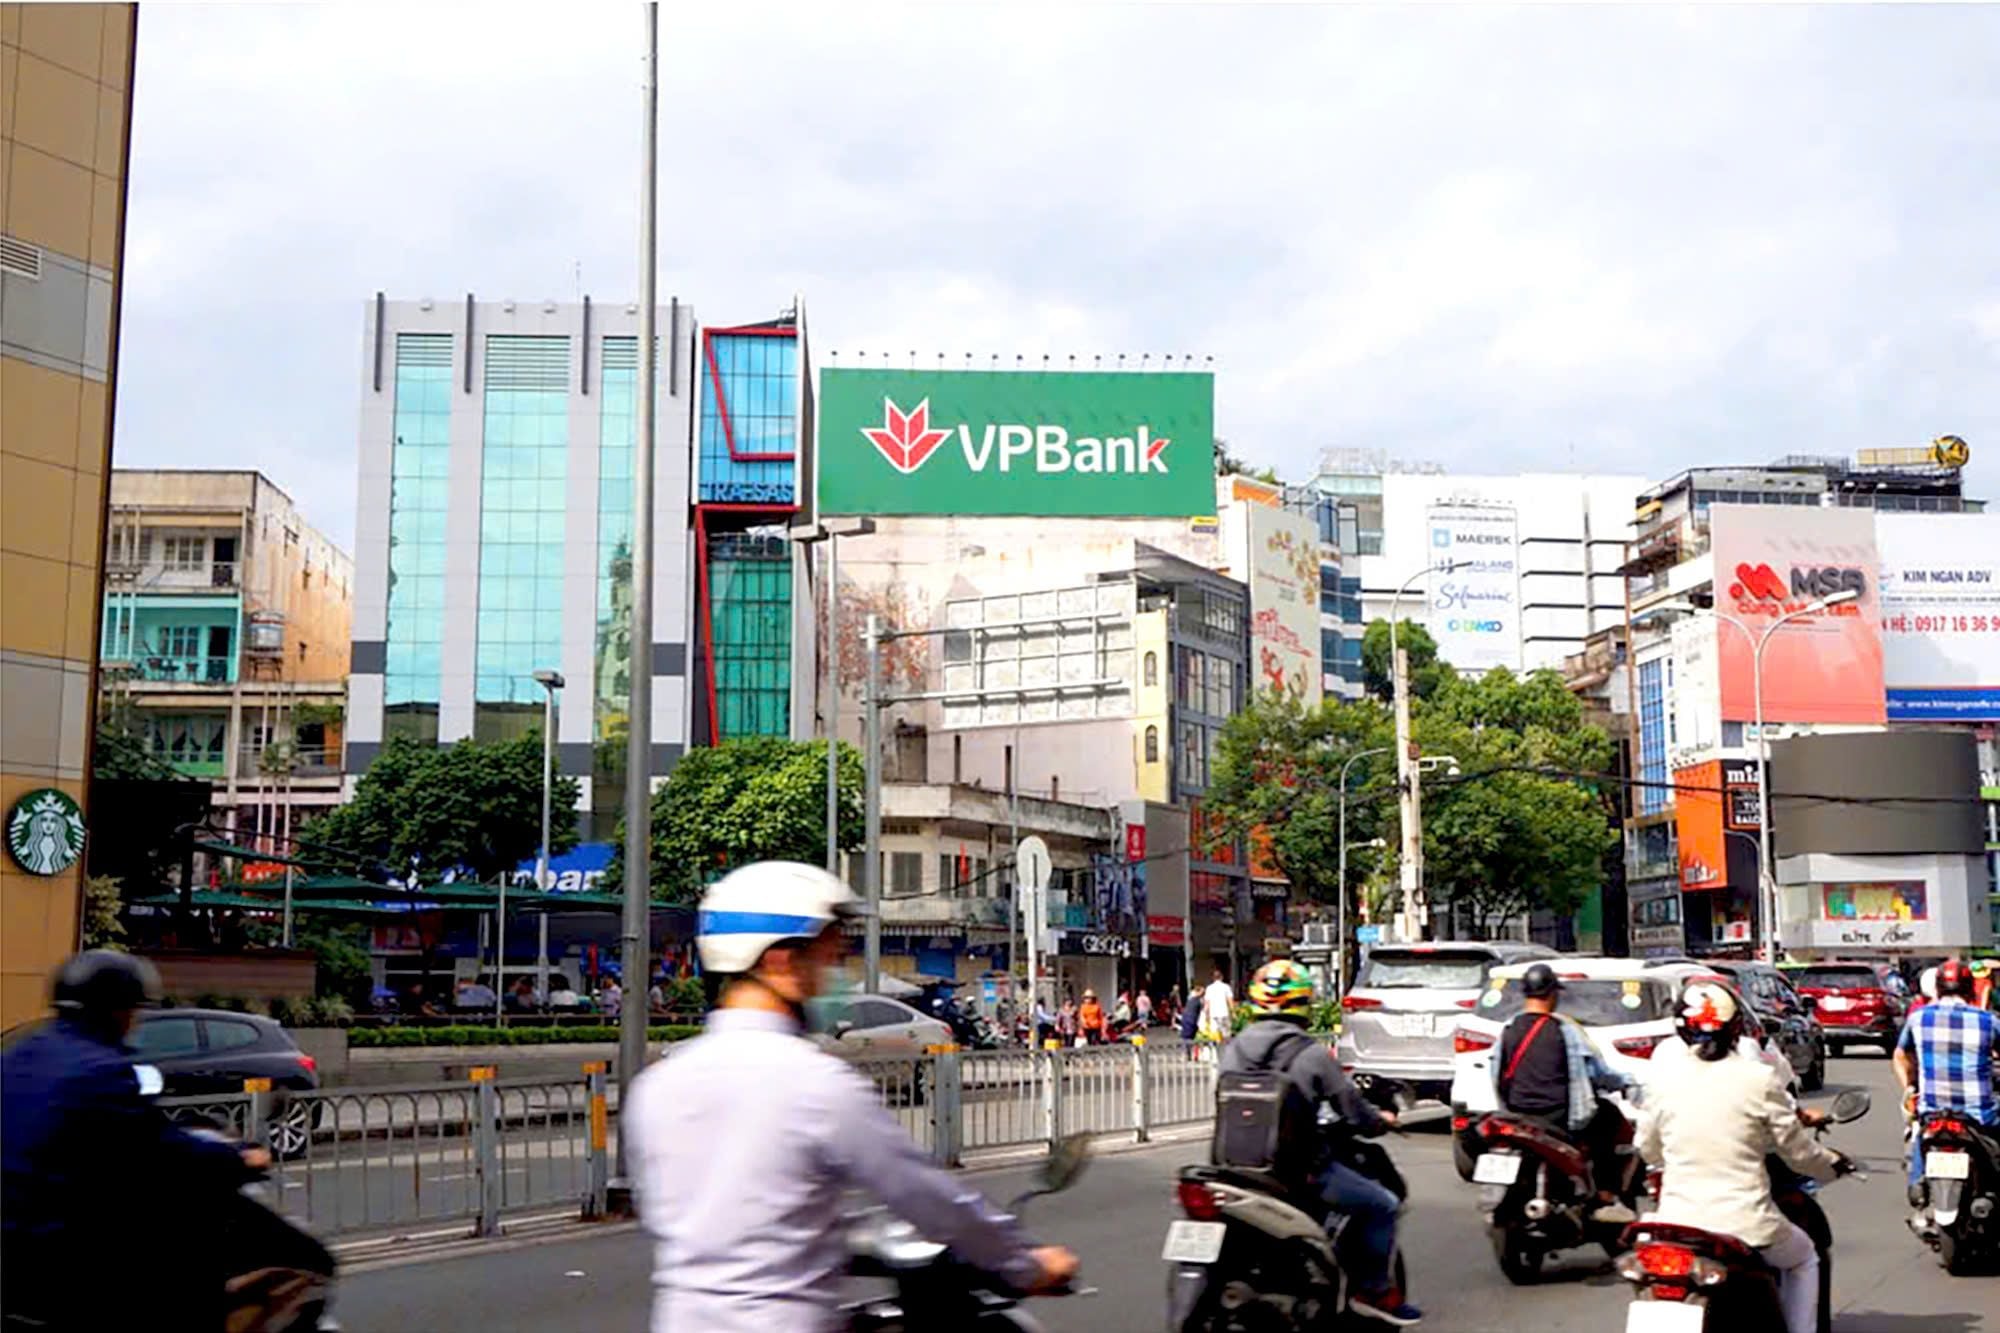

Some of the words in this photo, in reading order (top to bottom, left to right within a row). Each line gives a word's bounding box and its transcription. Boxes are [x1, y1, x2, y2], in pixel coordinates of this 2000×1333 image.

[958, 424, 1170, 473] VPBank
[1456, 534, 1511, 545] MAERSK
[1791, 567, 1865, 599] MSB
[1903, 570, 1927, 583] KIM
[1930, 570, 1964, 583] NGAN
[1967, 570, 1991, 583] ADV
[1915, 616, 1946, 632] 0917
[1952, 616, 1968, 632] 16
[1971, 616, 1988, 632] 36
